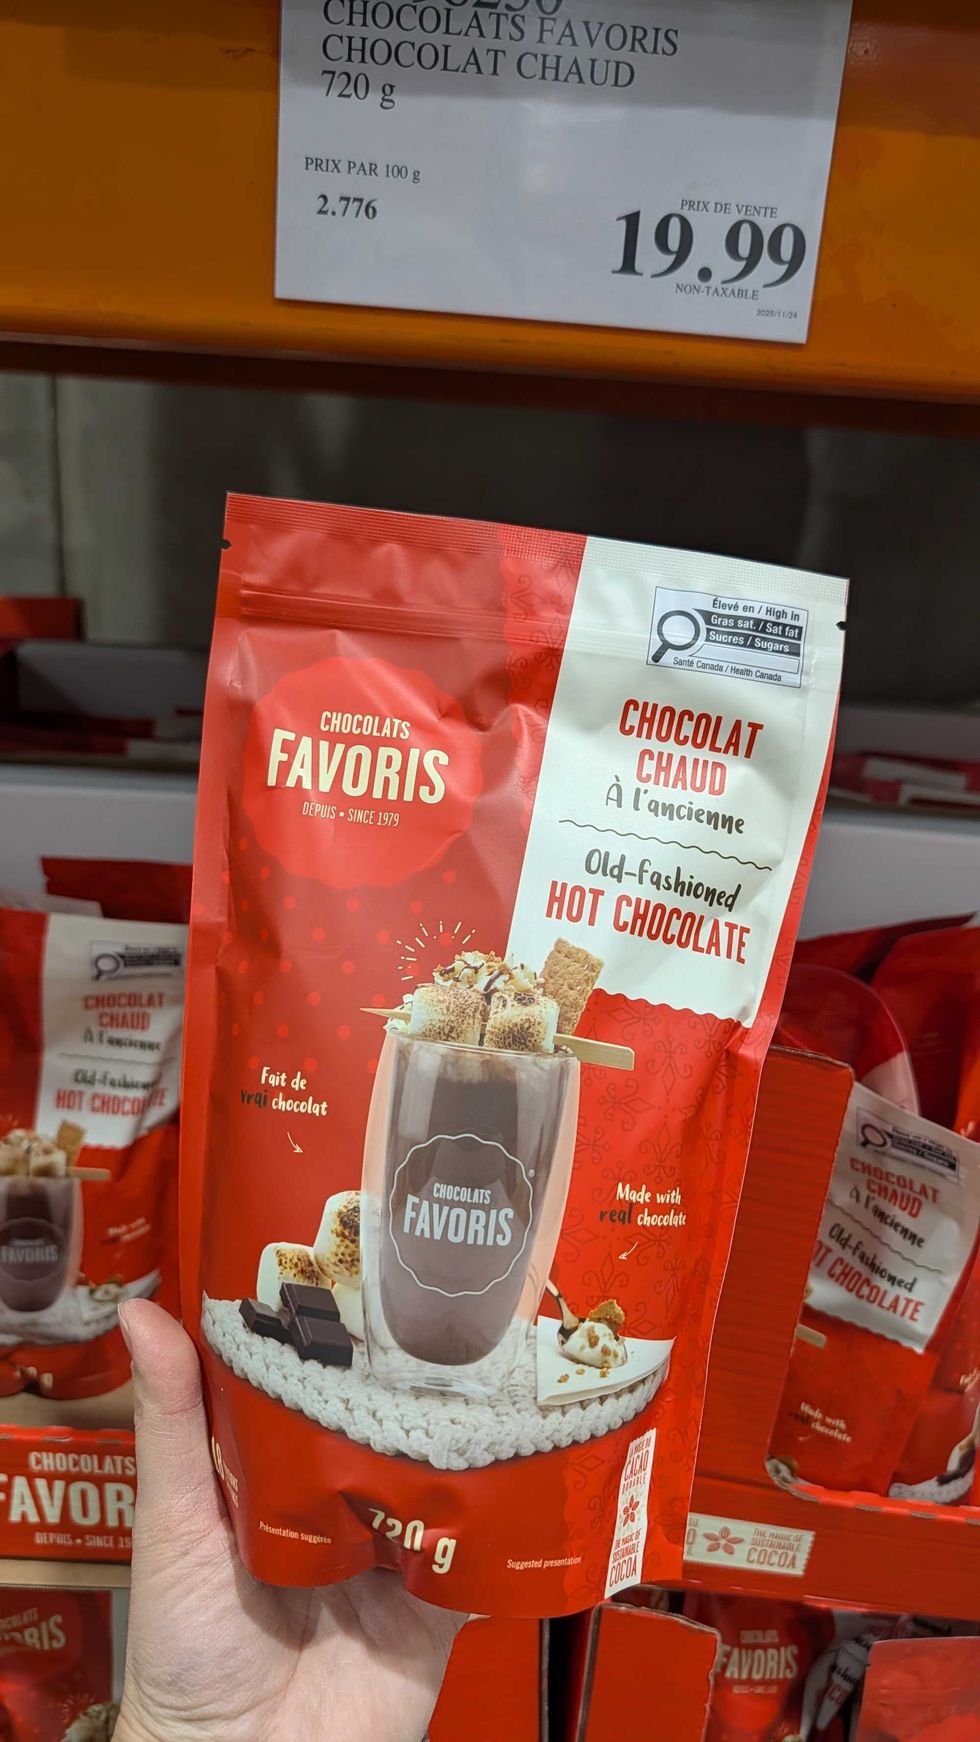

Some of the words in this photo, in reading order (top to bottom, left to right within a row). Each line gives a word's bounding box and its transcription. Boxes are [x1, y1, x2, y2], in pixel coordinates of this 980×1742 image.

[324, 1, 526, 42] CHOCOLATS
[537, 17, 679, 56] FAVORIS
[322, 34, 506, 77] CHOCOLAT
[516, 52, 635, 88] CHAUD
[320, 70, 370, 100] 720
[379, 82, 396, 109] g
[304, 156, 342, 174] PRIX
[347, 160, 379, 177] PAR
[385, 164, 409, 179] 100
[412, 169, 421, 184] g
[316, 193, 378, 220] 2.776
[680, 199, 709, 213] PRIX
[714, 202, 731, 215] DE
[736, 204, 778, 219] VENTE
[611, 210, 806, 288] 19.99
[675, 283, 760, 301] NON-TAXABLE
[712, 597, 739, 612] Élevé
[742, 602, 755, 613] en
[765, 606, 787, 621] High
[790, 611, 800, 622] in
[711, 614, 734, 627] Gras
[737, 619, 756, 630] sat.
[765, 622, 782, 635] Sat
[785, 626, 799, 638] fat
[709, 631, 744, 645] Sucres
[754, 638, 789, 653] Sugars
[673, 656, 694, 668] Santé
[696, 660, 724, 672] Canada
[730, 665, 753, 677] Health
[755, 669, 782, 682] Canada
[320, 711, 411, 740] CHOCOLATS
[618, 698, 763, 760] CHOCOLAT
[267, 728, 449, 804] FAVORIS
[636, 749, 728, 797] CHAUD
[302, 801, 337, 820] DEPUIS
[347, 808, 375, 825] SINCE
[377, 811, 400, 827] 1979
[605, 775, 623, 809] À
[632, 785, 745, 835] l'ancienne
[584, 847, 742, 913] Old-fashioned
[545, 880, 605, 926] HOT
[613, 894, 751, 965] CHOCOLATE
[83, 991, 165, 1010] CHOCOLAT
[98, 1010, 150, 1031] CHAUD
[261, 1066, 287, 1088] Fait
[290, 1071, 307, 1090] de
[55, 1087, 84, 1111] HOT
[240, 1089, 269, 1108] vrai
[271, 1092, 328, 1117] chocolat
[432, 1182, 492, 1205] CHOCOLATS
[616, 1182, 652, 1204] Made
[656, 1187, 682, 1205] with
[849, 1156, 939, 1204] CHOCOLAT
[866, 1178, 922, 1219] CHAUD
[403, 1193, 514, 1246] FAVORIS
[599, 1202, 634, 1226] real
[637, 1208, 687, 1227] chocolate
[828, 1222, 918, 1294] Old-fashioned
[827, 1256, 925, 1323] CHOCOLATE
[28, 1451, 136, 1476] CHOCOLATS
[624, 1449, 649, 1482] CACAO
[0, 1472, 134, 1528] AVOR
[259, 1520, 299, 1540] Présentation
[368, 1507, 425, 1552] 720
[431, 1536, 457, 1575] g
[507, 1558, 542, 1571] Suggested
[543, 1555, 582, 1569] presentation
[612, 1541, 640, 1564] SUSTAINABLE
[746, 1547, 797, 1569] COCOA
[609, 1555, 637, 1588] COCOA
[716, 1643, 798, 1680] FAVORIS
